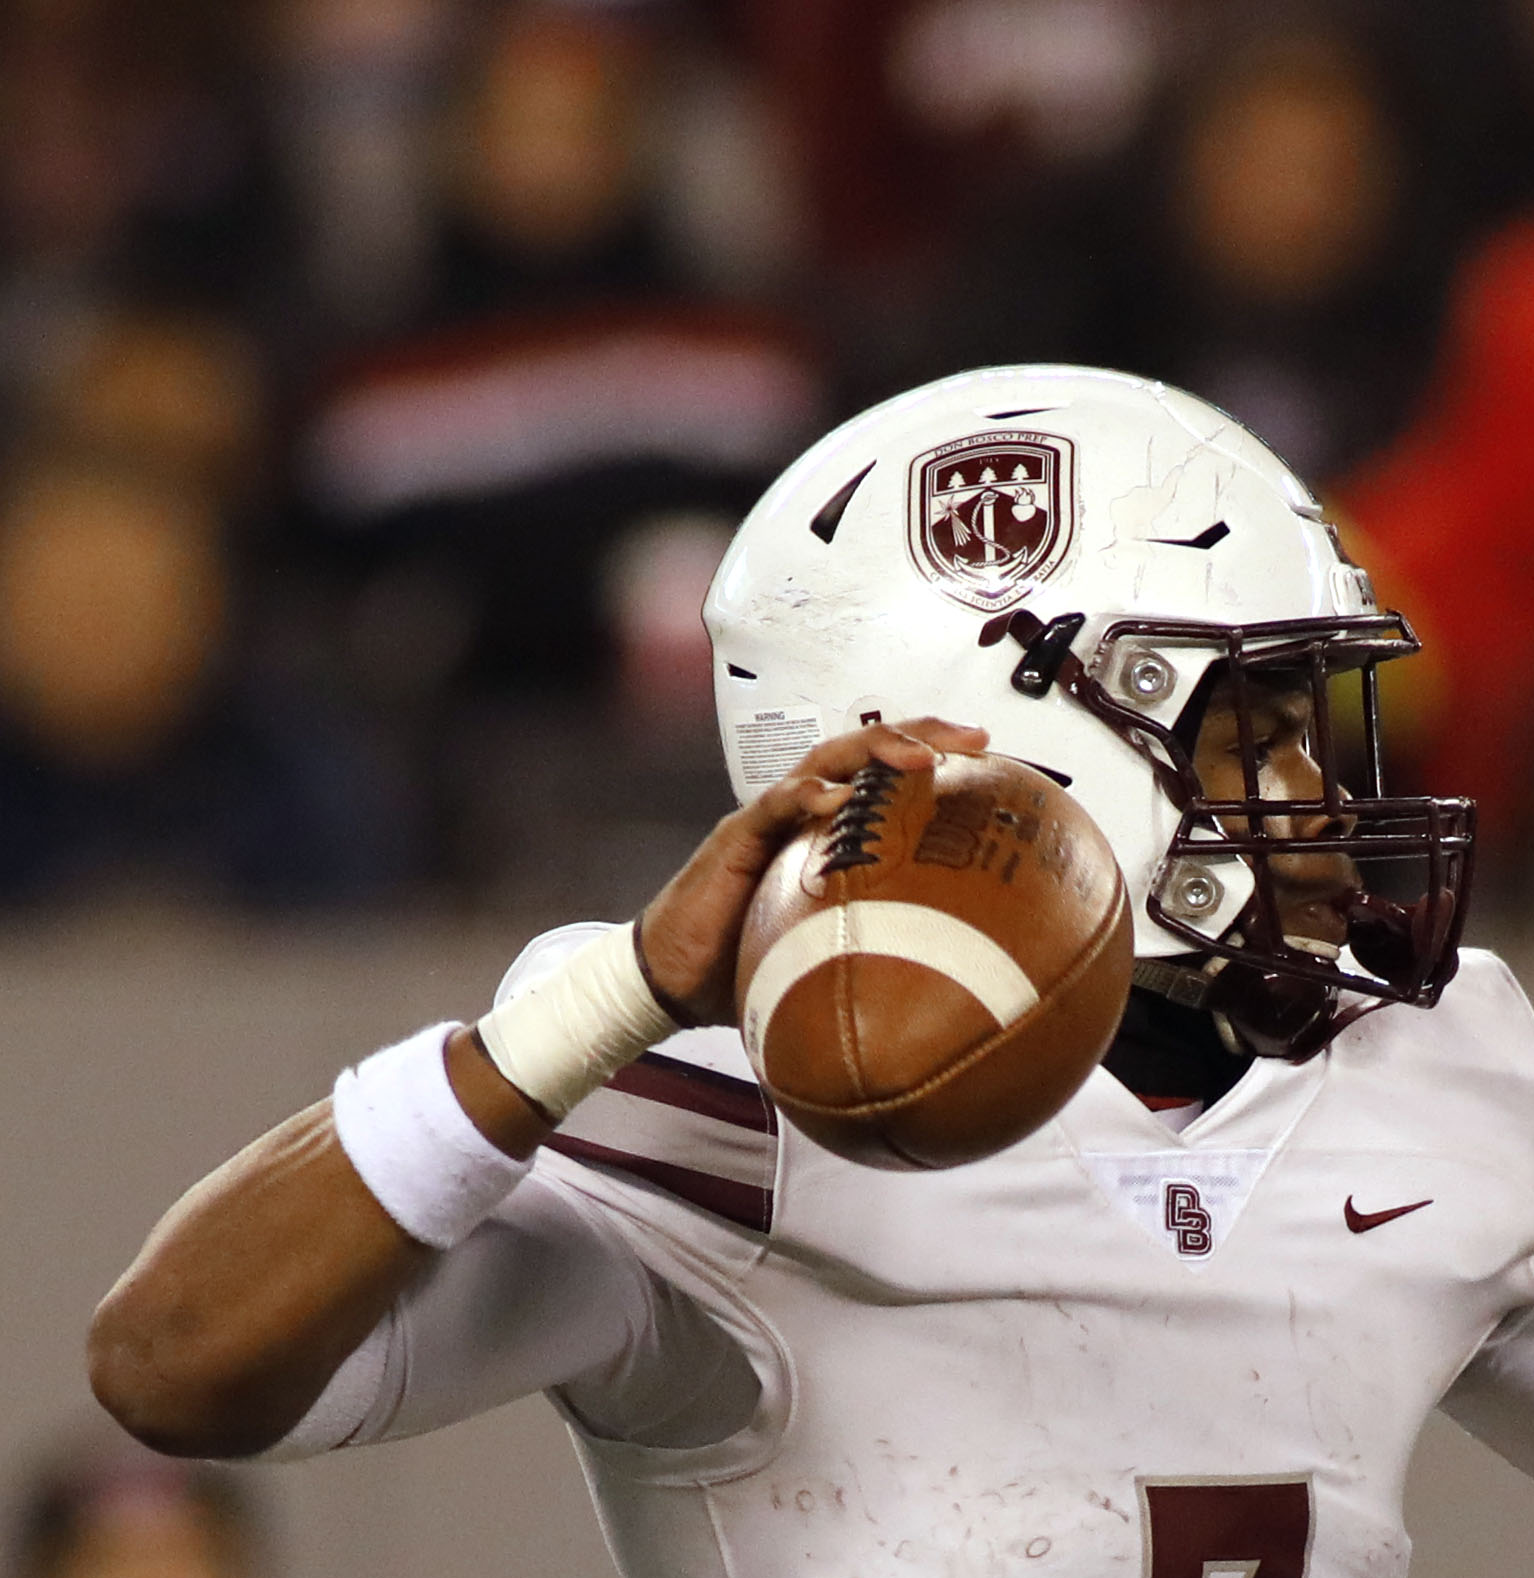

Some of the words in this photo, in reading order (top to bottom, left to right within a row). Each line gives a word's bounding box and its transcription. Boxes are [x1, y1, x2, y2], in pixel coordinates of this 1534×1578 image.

[934, 441, 963, 458] DON
[968, 433, 1014, 446] BOSCO
[1017, 432, 1048, 444] PREP
[754, 711, 785, 722] WARNING
[1166, 1184, 1212, 1255] DB
